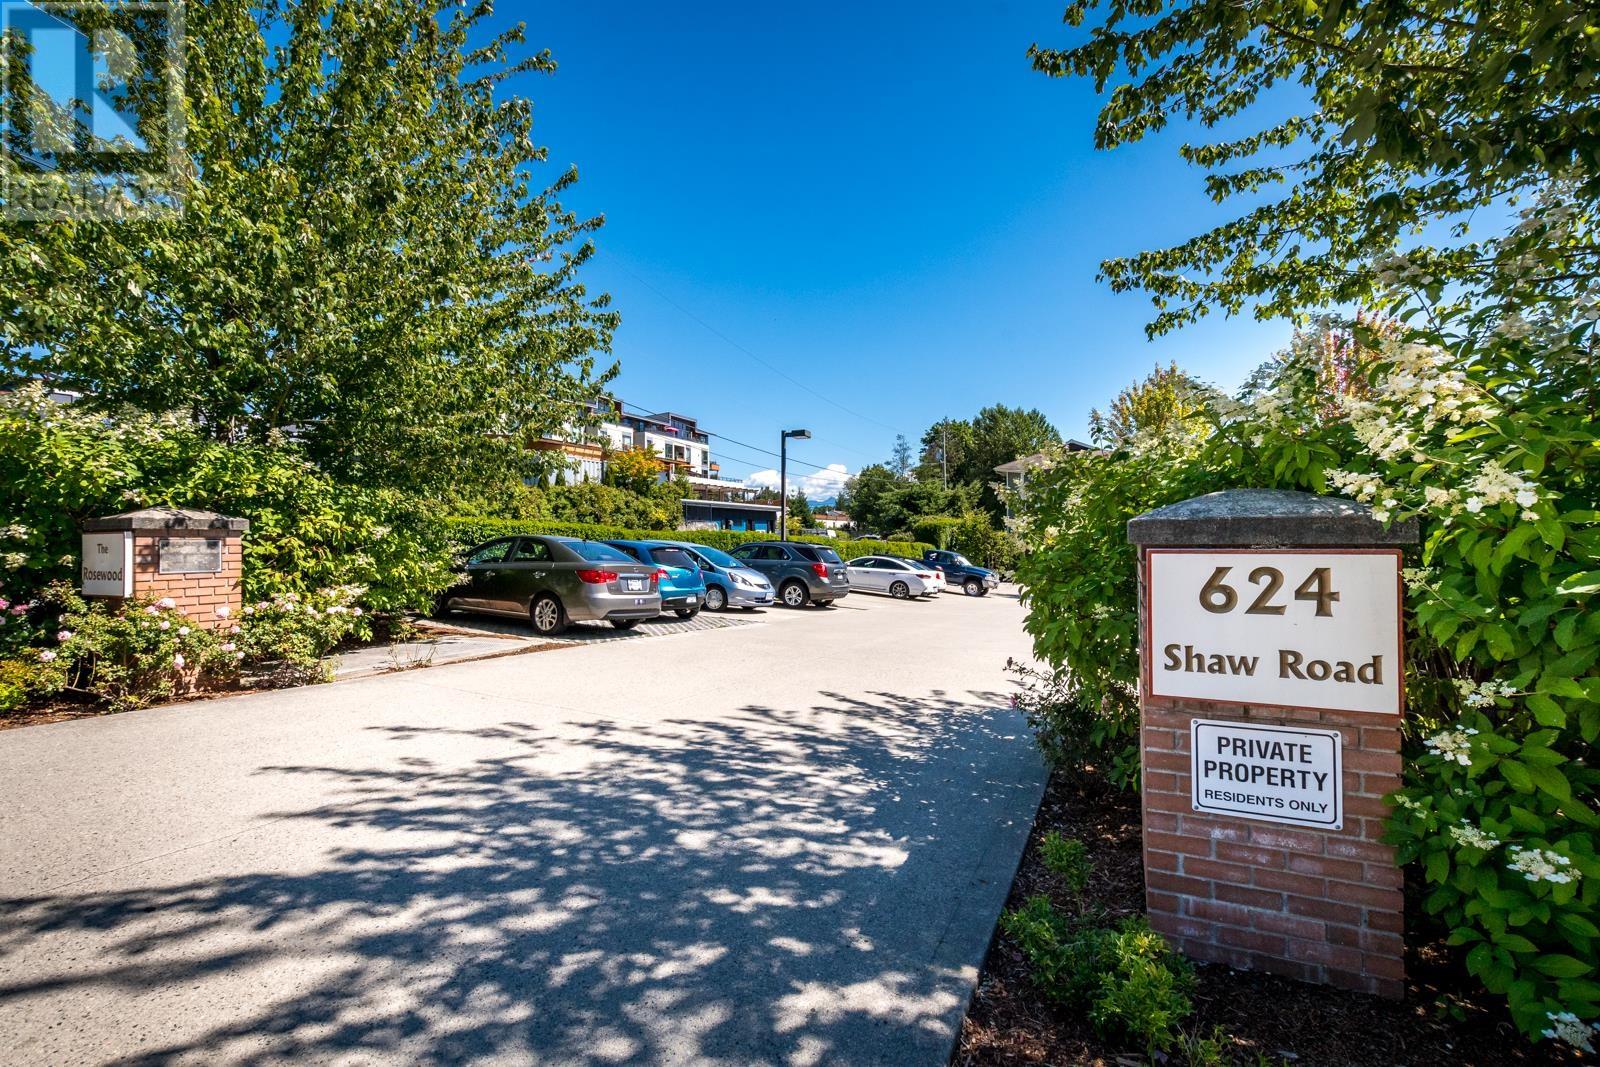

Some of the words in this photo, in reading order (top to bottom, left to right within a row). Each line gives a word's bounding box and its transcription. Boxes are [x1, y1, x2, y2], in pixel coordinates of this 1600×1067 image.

[97, 543, 109, 554] The
[83, 566, 123, 581] Rosewood
[1199, 566, 1340, 617] 624
[1164, 643, 1259, 676] Shaw
[1278, 649, 1384, 685] Road
[1217, 736, 1313, 764] PRIVATE
[1204, 760, 1328, 791] PROPERTY
[1204, 789, 1285, 809] RESIDENTS
[1289, 799, 1328, 814] ONLY
